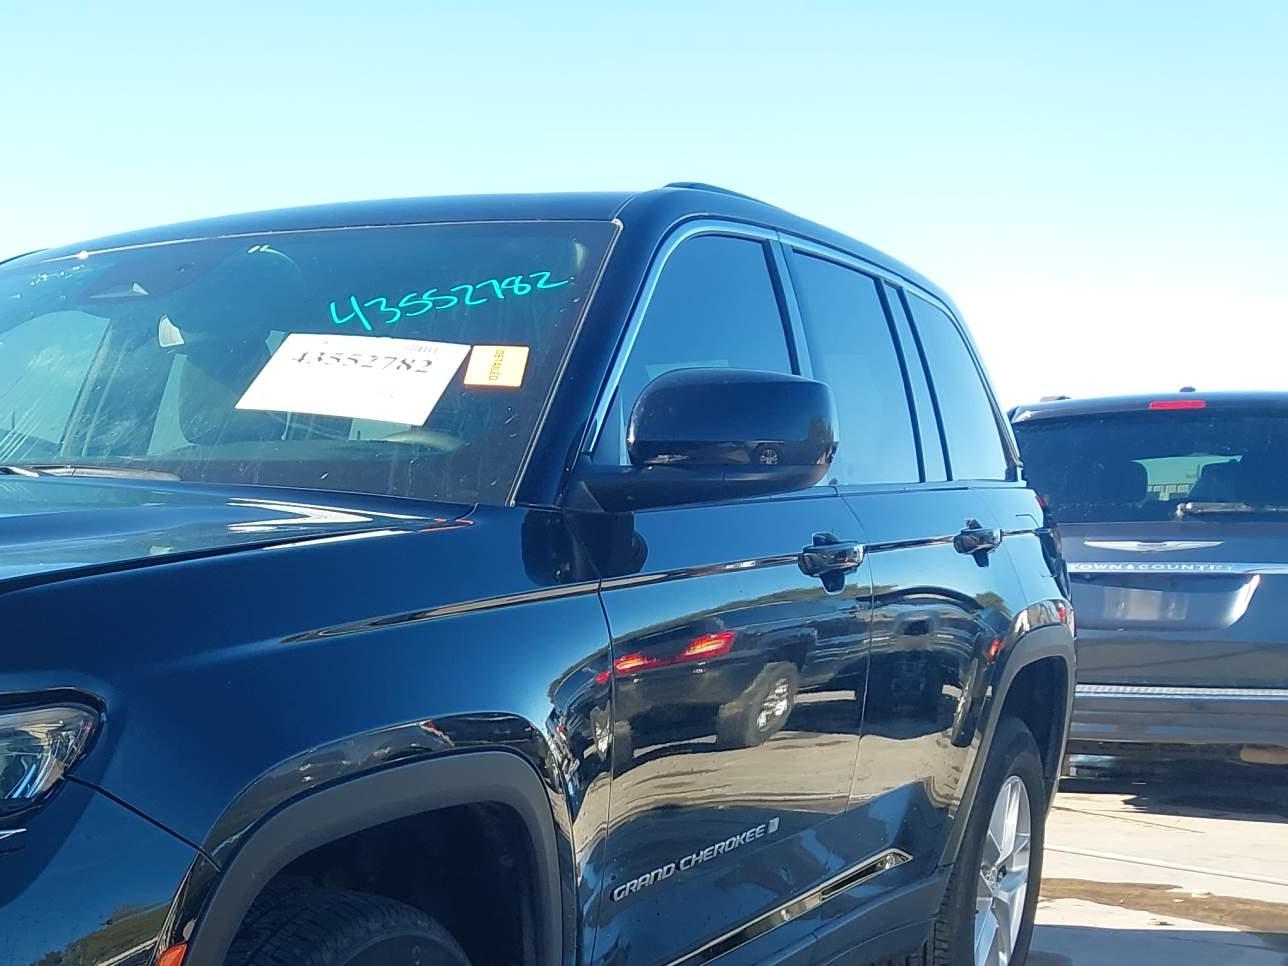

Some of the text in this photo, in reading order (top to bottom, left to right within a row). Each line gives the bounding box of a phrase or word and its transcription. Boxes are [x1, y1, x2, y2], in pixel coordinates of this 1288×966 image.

[329, 271, 568, 331] 43552782
[291, 350, 433, 374] 43552782
[611, 823, 766, 902] GRAND CHEROKEE
